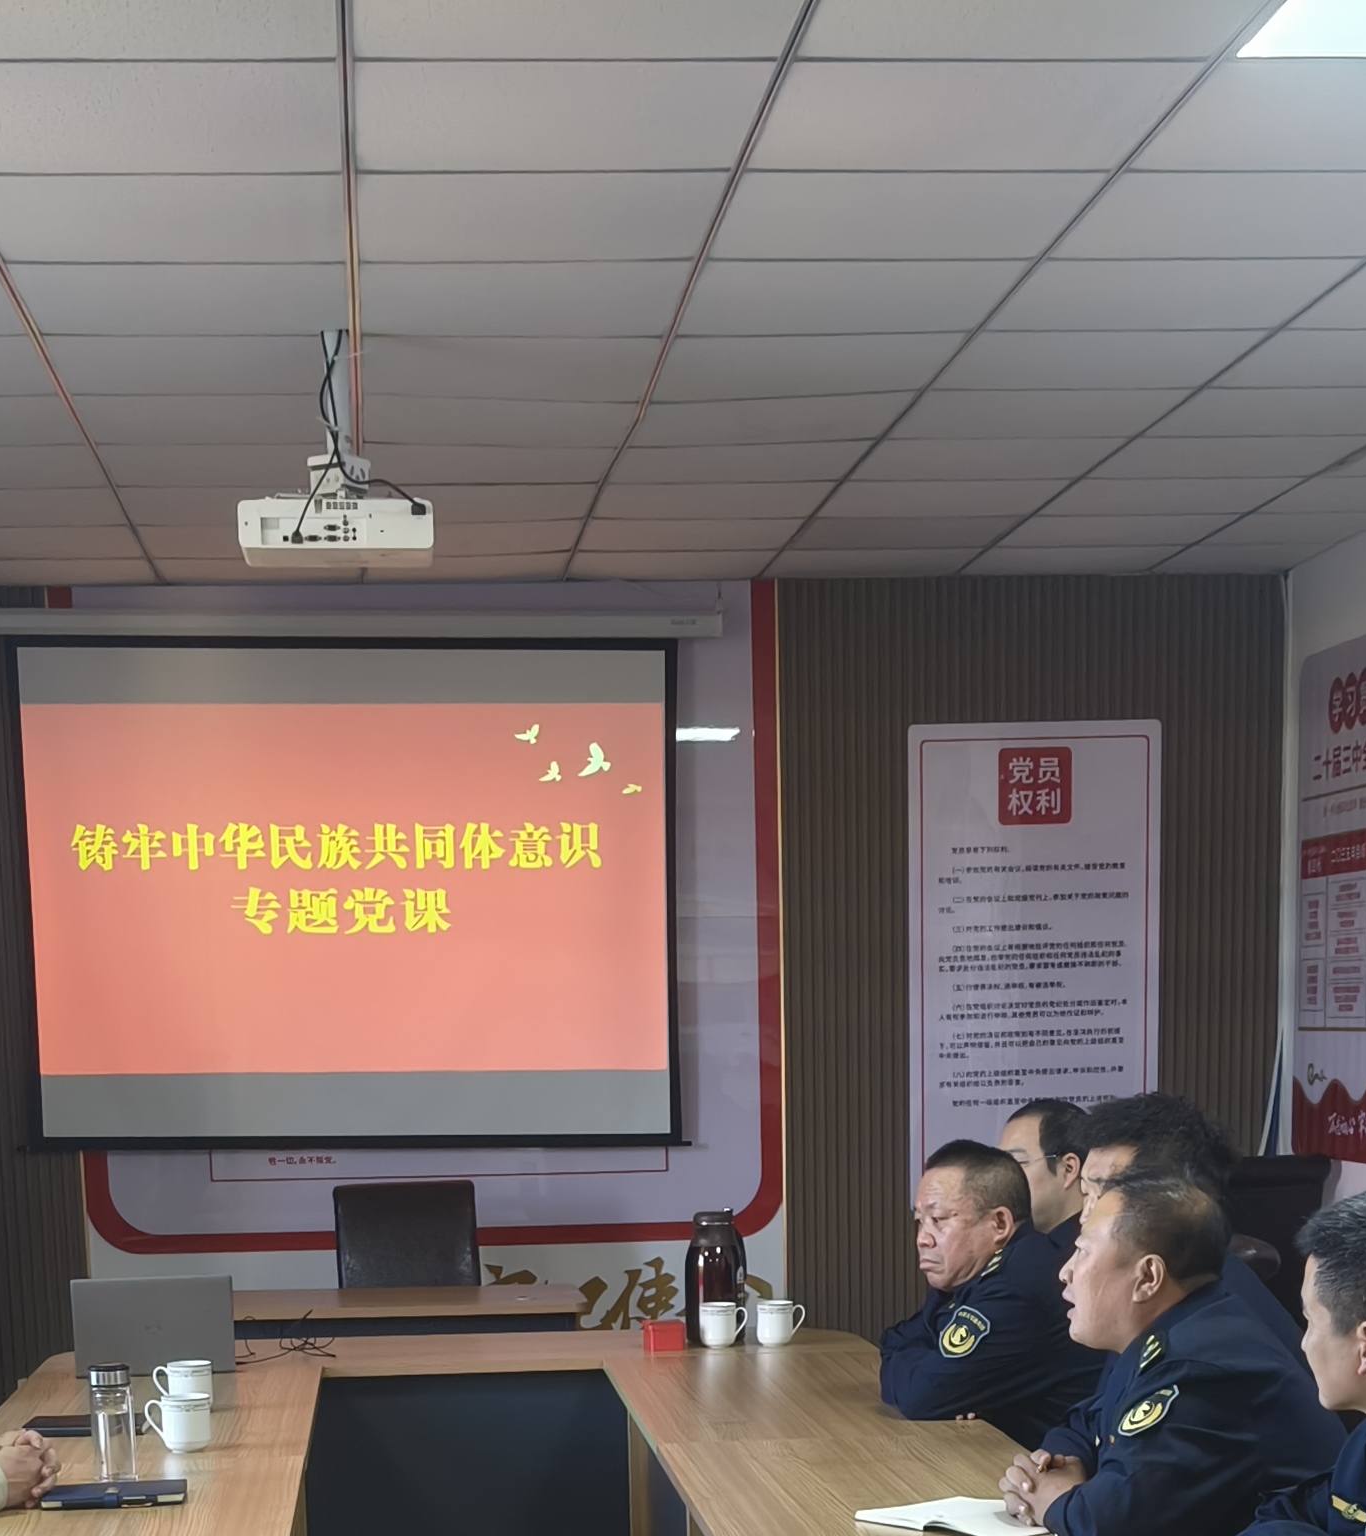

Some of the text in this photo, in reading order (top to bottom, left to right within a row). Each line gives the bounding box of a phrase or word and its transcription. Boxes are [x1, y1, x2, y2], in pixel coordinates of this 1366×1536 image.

[1008, 756, 1061, 785] 党员
[1008, 788, 1061, 816] 权利
[71, 820, 603, 872] 铸牢中华民族共同体意识
[230, 886, 452, 935] 专题党课
